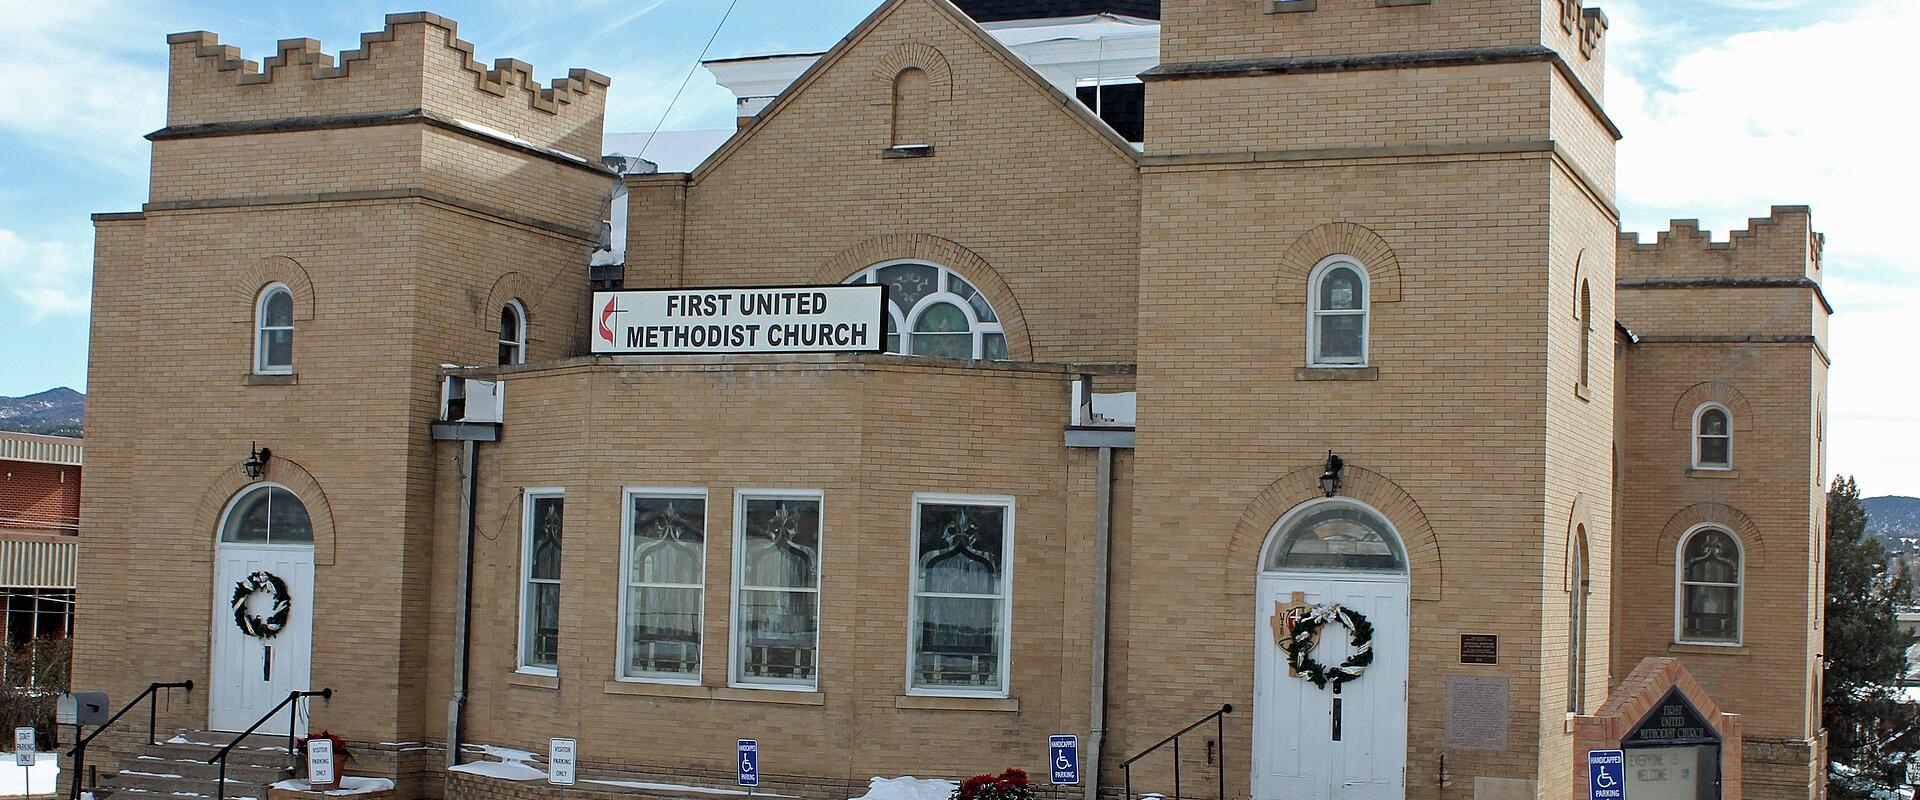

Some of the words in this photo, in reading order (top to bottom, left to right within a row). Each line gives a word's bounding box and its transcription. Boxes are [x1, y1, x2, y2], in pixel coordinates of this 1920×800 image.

[667, 295, 732, 316] FIRST
[740, 293, 827, 315] UNITED
[626, 325, 760, 348] METHODIST
[767, 323, 867, 346] CHURCH
[1663, 705, 1683, 716] FIRST
[1661, 717, 1685, 727] UNITED
[1640, 728, 1676, 739] METHODIST
[1677, 728, 1704, 738] CHURCH
[17, 743, 34, 751] PARKING
[1051, 740, 1075, 748] HANDICAPPED
[20, 754, 31, 762] ONLY
[553, 757, 571, 765] PARKING
[1590, 755, 1622, 764] HANDICAPPED
[1055, 771, 1075, 779] PARKING
[1595, 789, 1620, 798] PARKING
